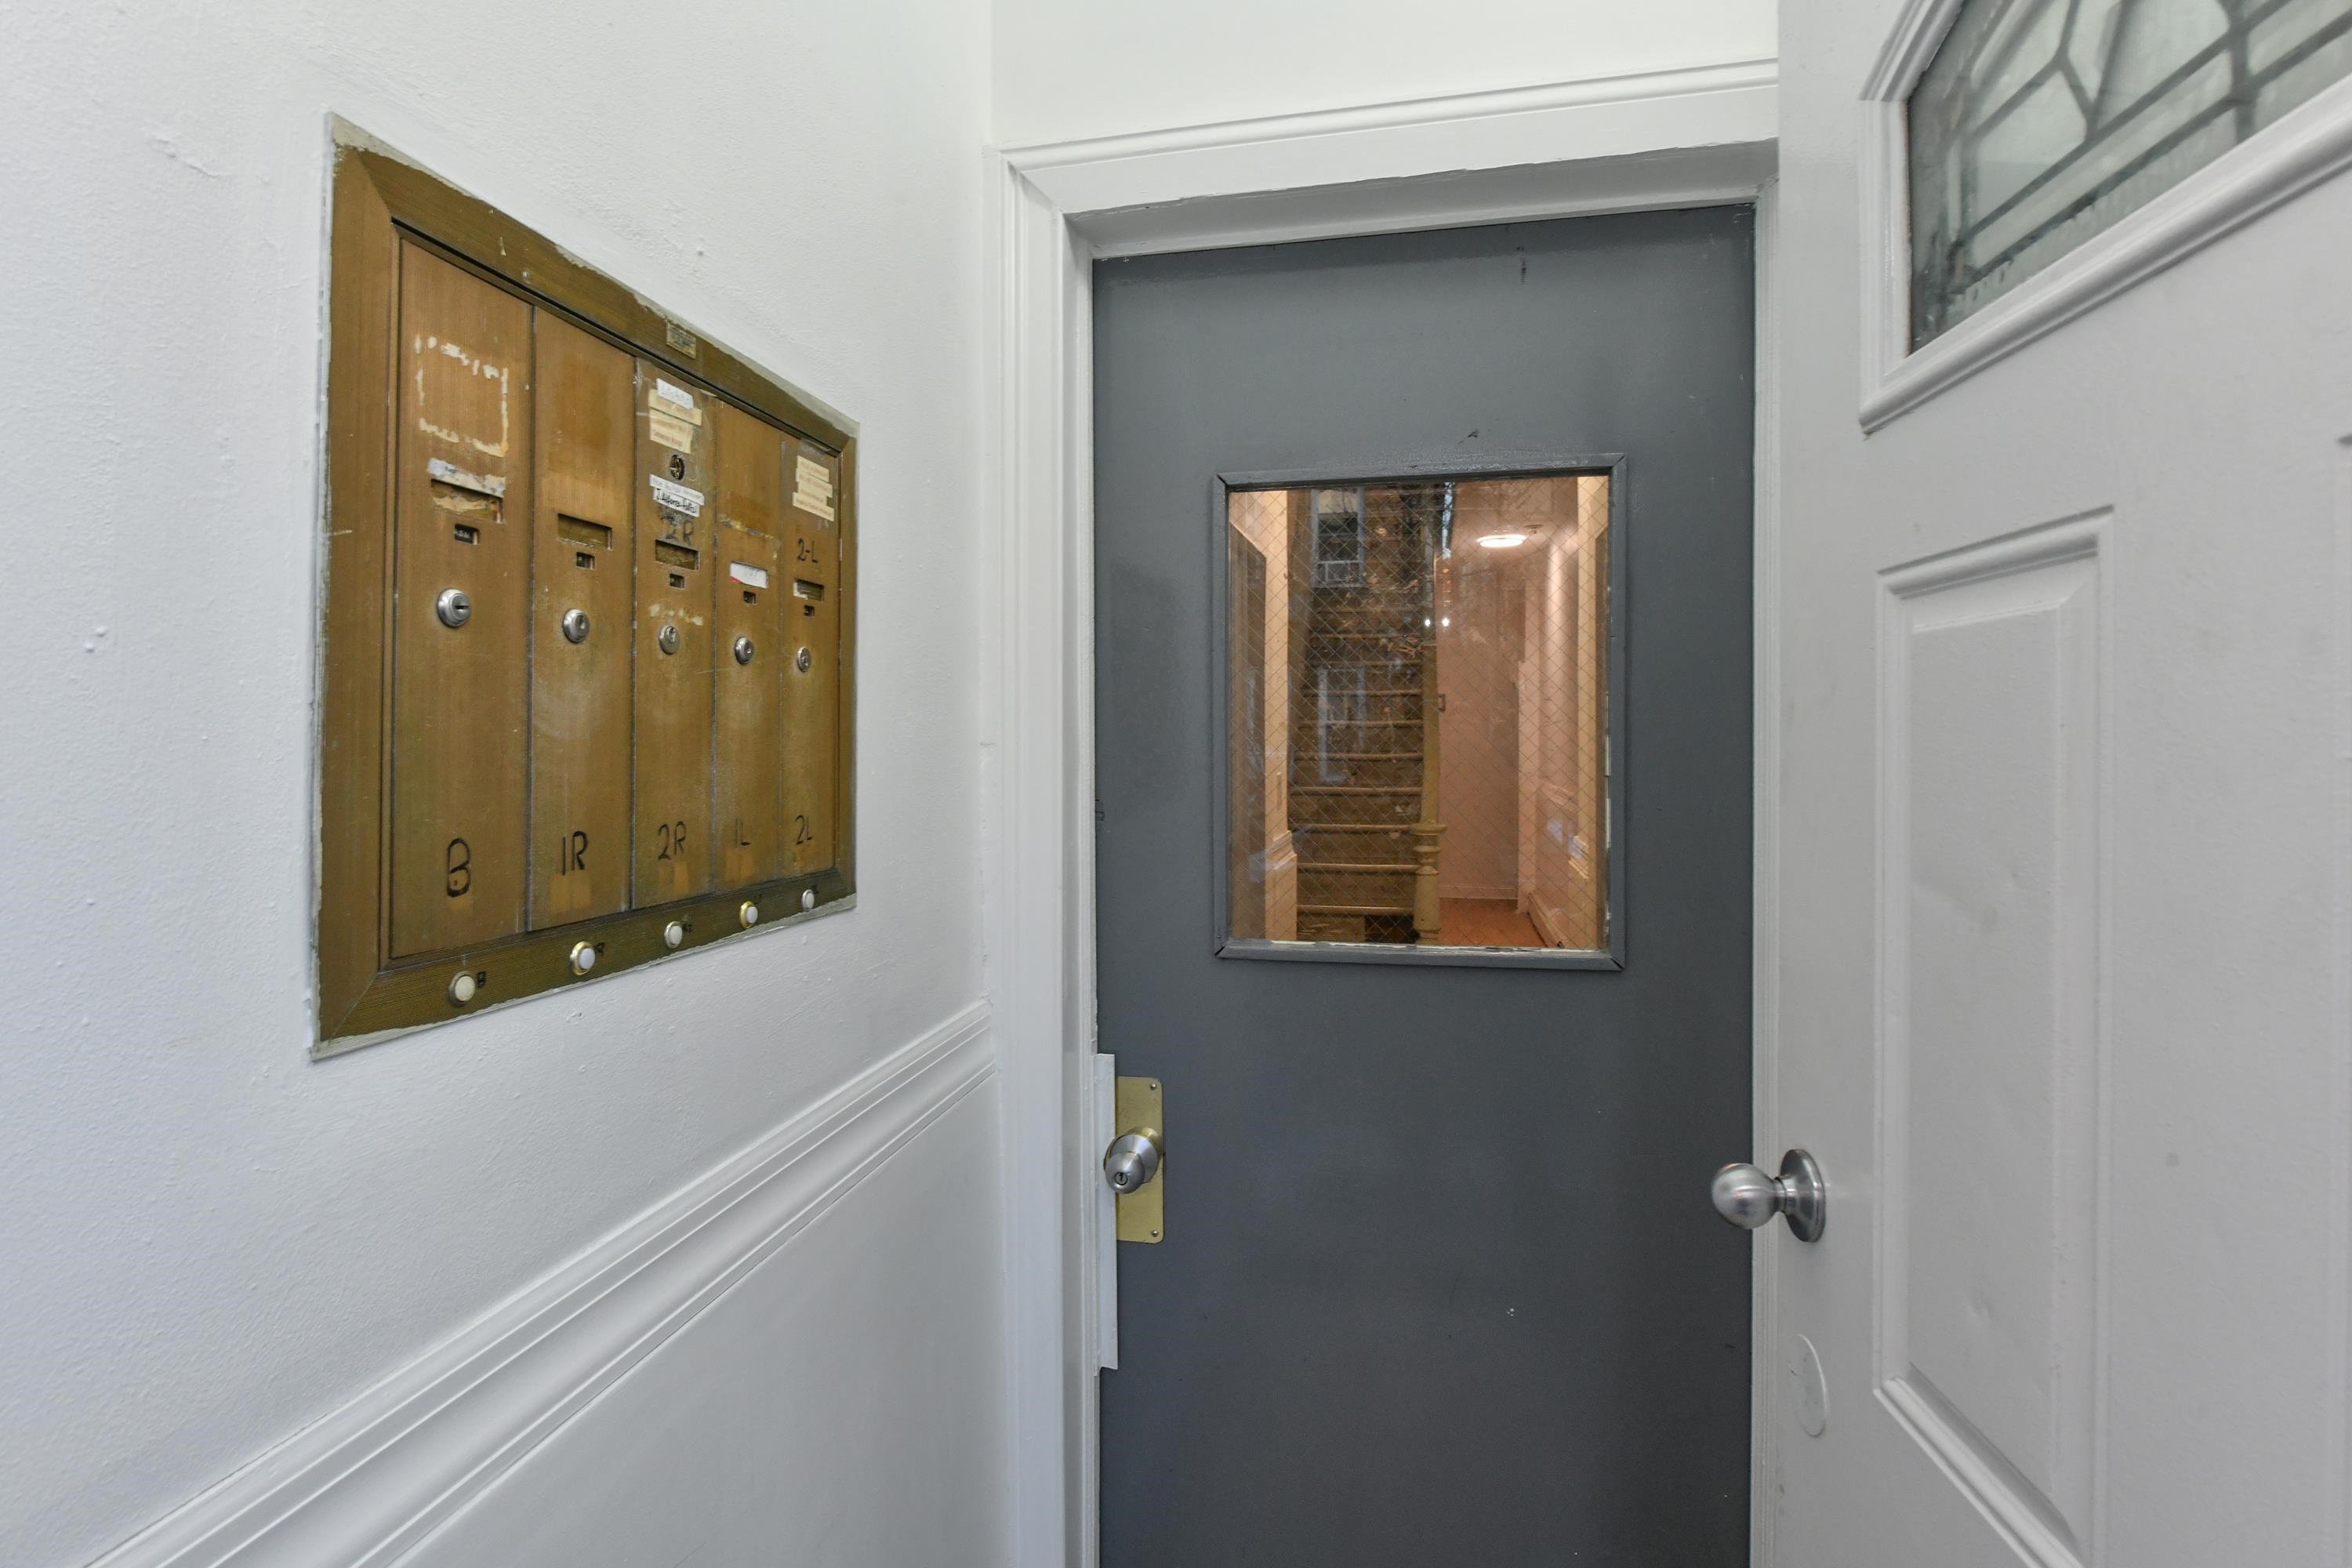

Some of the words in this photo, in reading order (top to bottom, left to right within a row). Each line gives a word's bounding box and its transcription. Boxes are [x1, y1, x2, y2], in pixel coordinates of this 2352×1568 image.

[797, 537, 818, 563] 2-L
[658, 820, 687, 861] 2R
[795, 815, 813, 845] 2L
[447, 837, 471, 898] B
[561, 830, 588, 876] 1R
